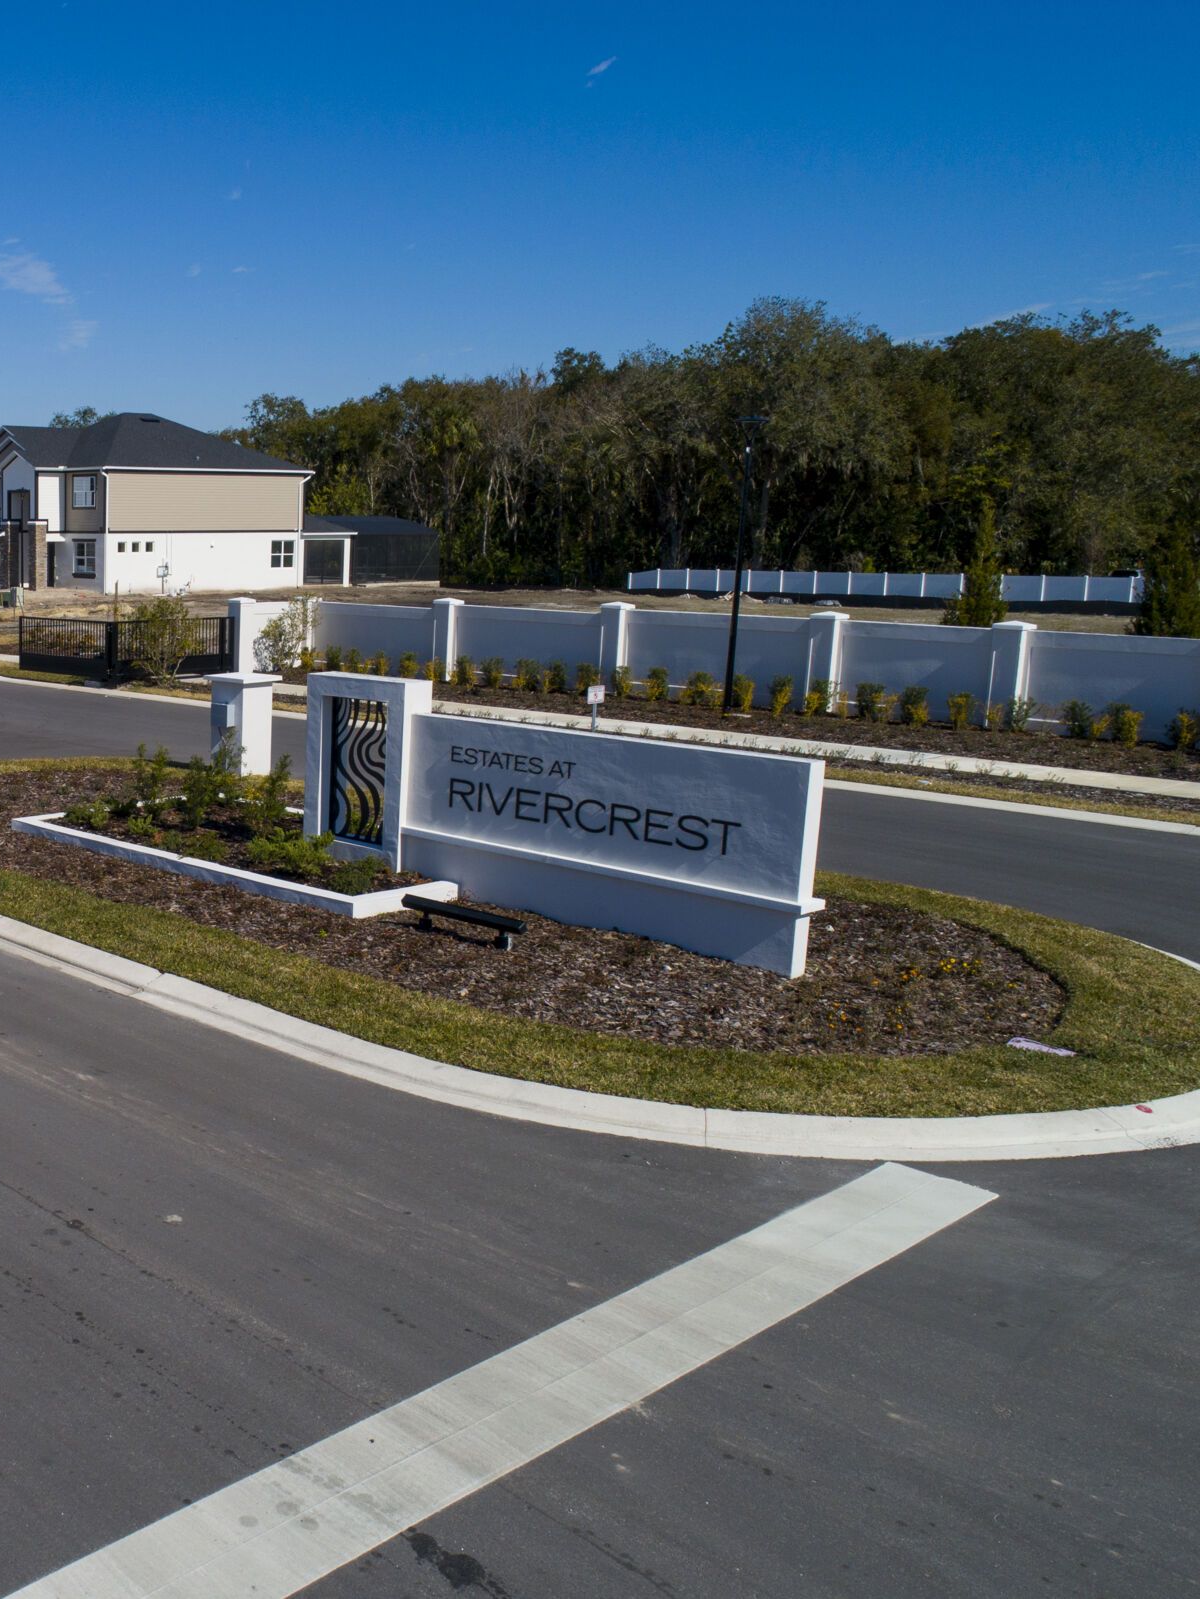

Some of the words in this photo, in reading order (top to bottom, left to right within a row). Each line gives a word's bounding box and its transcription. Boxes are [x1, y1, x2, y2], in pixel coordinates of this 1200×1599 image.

[450, 745, 544, 775] ESTATES
[548, 761, 576, 779] AT
[448, 778, 742, 855] RIVERCREST
